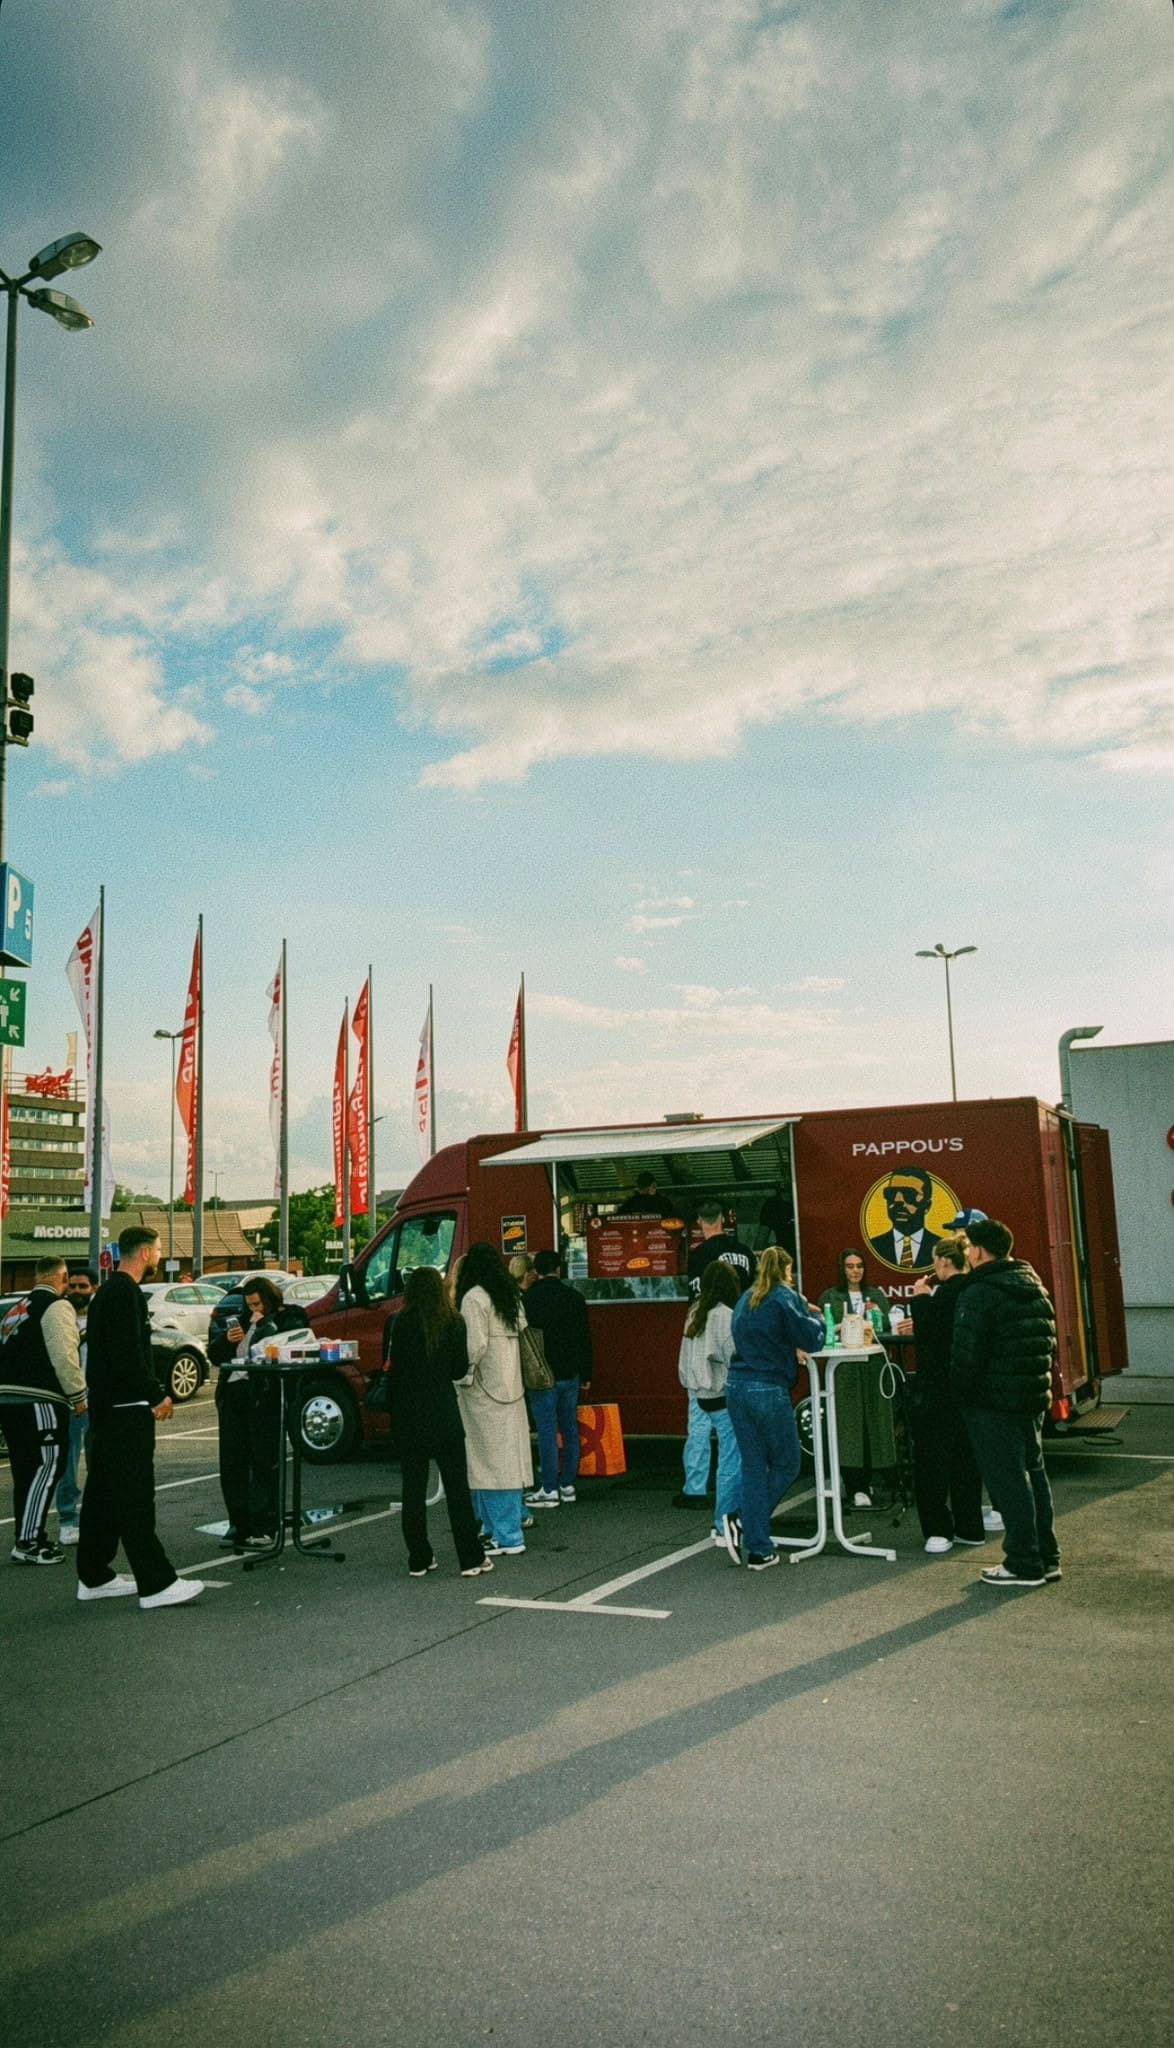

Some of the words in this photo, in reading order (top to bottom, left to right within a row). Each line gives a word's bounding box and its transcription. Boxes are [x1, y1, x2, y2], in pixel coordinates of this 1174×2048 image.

[7, 873, 22, 929] P
[852, 1137, 964, 1157] PAPPOU'S
[33, 1225, 110, 1238] McDonas
